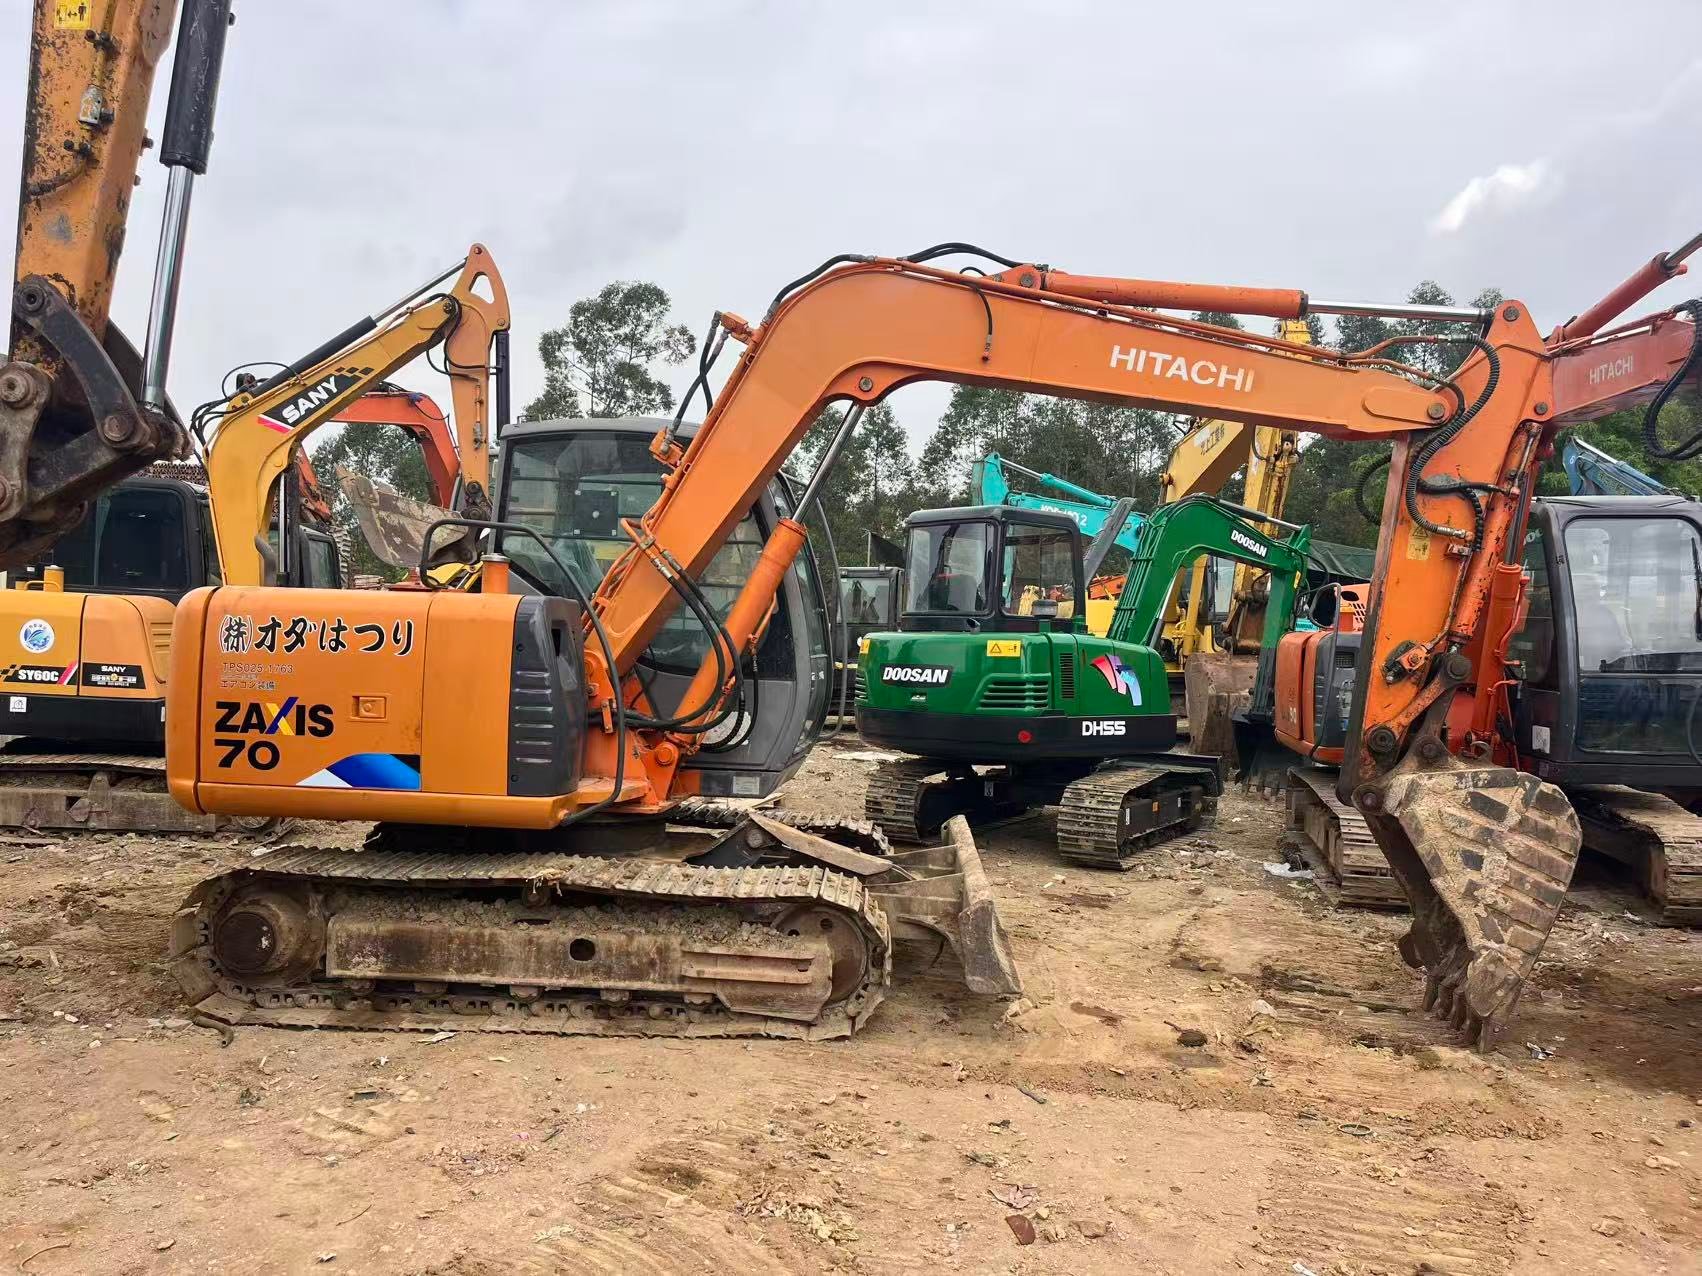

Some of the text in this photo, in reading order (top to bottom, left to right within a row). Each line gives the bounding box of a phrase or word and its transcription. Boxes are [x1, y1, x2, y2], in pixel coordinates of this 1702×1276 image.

[1109, 344, 1255, 393] HITACHI
[1589, 354, 1633, 384] HITACHI
[282, 375, 338, 424] SANY
[1231, 529, 1268, 558] DOOSAN
[18, 669, 59, 682] SY60C
[882, 666, 949, 684] DOOSAN
[215, 696, 335, 738] ZAXIS
[1082, 720, 1127, 736] DH55
[214, 738, 281, 771] 70
